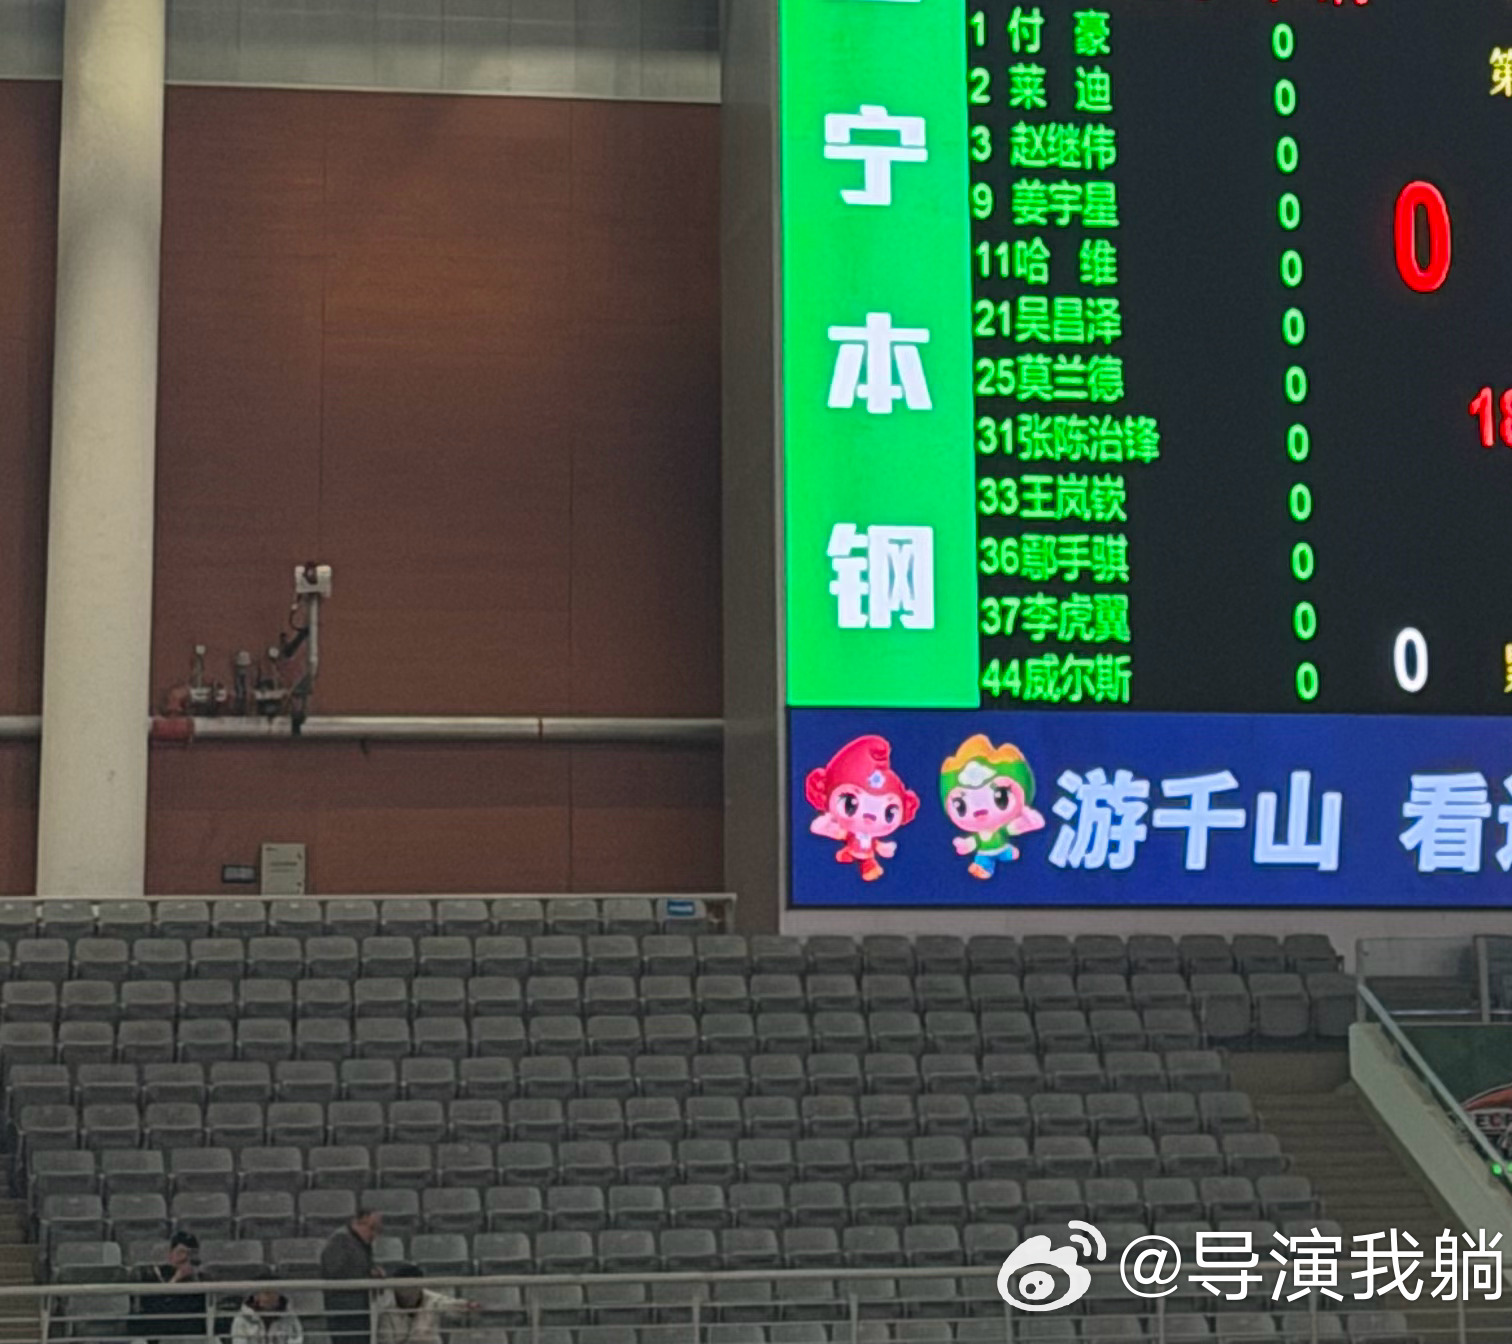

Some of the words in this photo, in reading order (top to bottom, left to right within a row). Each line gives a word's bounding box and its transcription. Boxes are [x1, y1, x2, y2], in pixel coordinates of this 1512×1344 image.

[970, 11, 985, 46] 1
[1272, 24, 1293, 59] 0
[969, 67, 991, 104] 2
[1275, 79, 1295, 115] 0
[971, 125, 992, 162] 3
[1010, 120, 1116, 170] 赵继伟
[1277, 137, 1298, 172] 0
[972, 182, 993, 220] 9
[1012, 178, 1120, 227] 姜宇星
[1279, 193, 1300, 229] 0
[1395, 181, 1451, 293] 0
[1281, 250, 1302, 286] 0
[1283, 308, 1304, 345] 0
[1286, 366, 1307, 402] 0
[1288, 424, 1309, 461] 0
[1290, 483, 1311, 520] 0
[1292, 543, 1313, 580] 0
[1294, 602, 1316, 640] 0
[1394, 628, 1428, 693] 0
[1296, 662, 1318, 700] 0
[1051, 769, 1342, 870] 游千山
